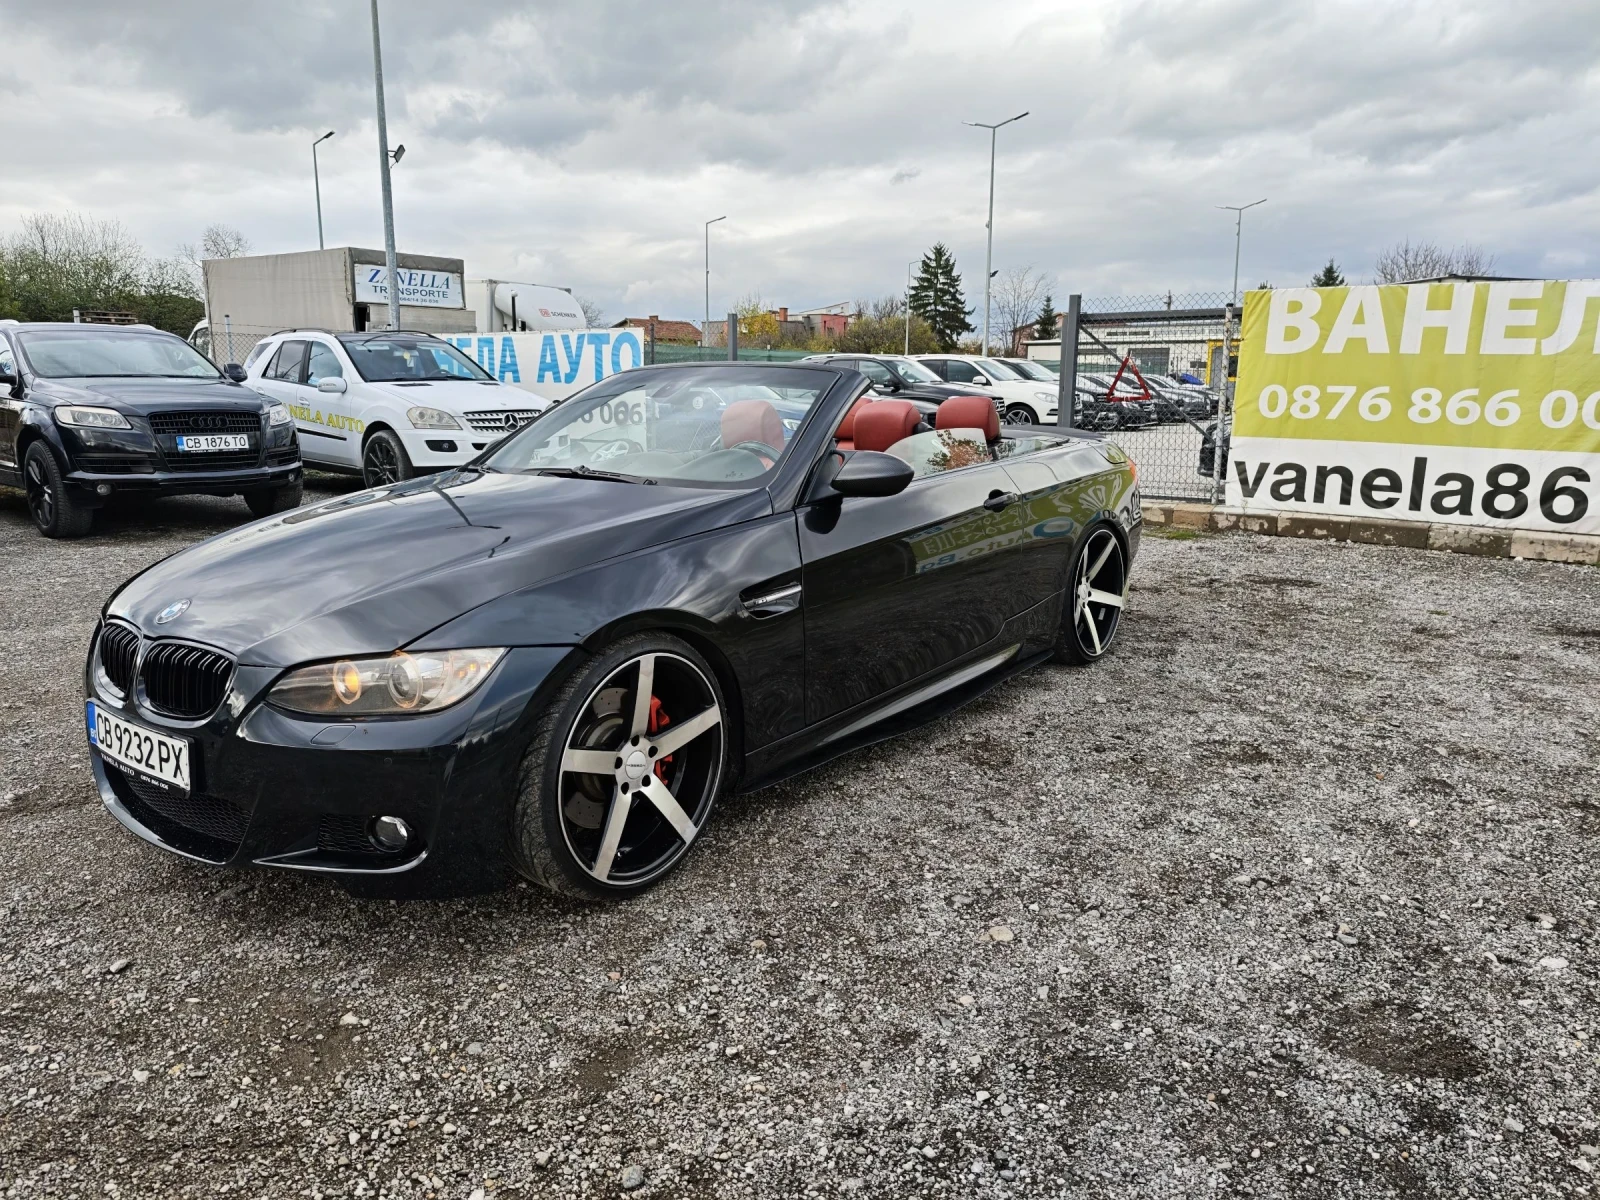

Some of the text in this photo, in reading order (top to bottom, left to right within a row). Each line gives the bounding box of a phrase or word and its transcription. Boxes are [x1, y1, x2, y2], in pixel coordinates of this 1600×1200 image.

[368, 268, 450, 290] ZNELLA
[372, 285, 449, 299] TRNSPORTE
[551, 311, 577, 319] SCHENKER
[537, 331, 641, 384] АУТО
[1258, 384, 1392, 422] 0876
[1408, 388, 1521, 427] 866
[326, 412, 366, 435] AUTO
[204, 436, 231, 448] 1876
[1233, 456, 1592, 524] vanela86
